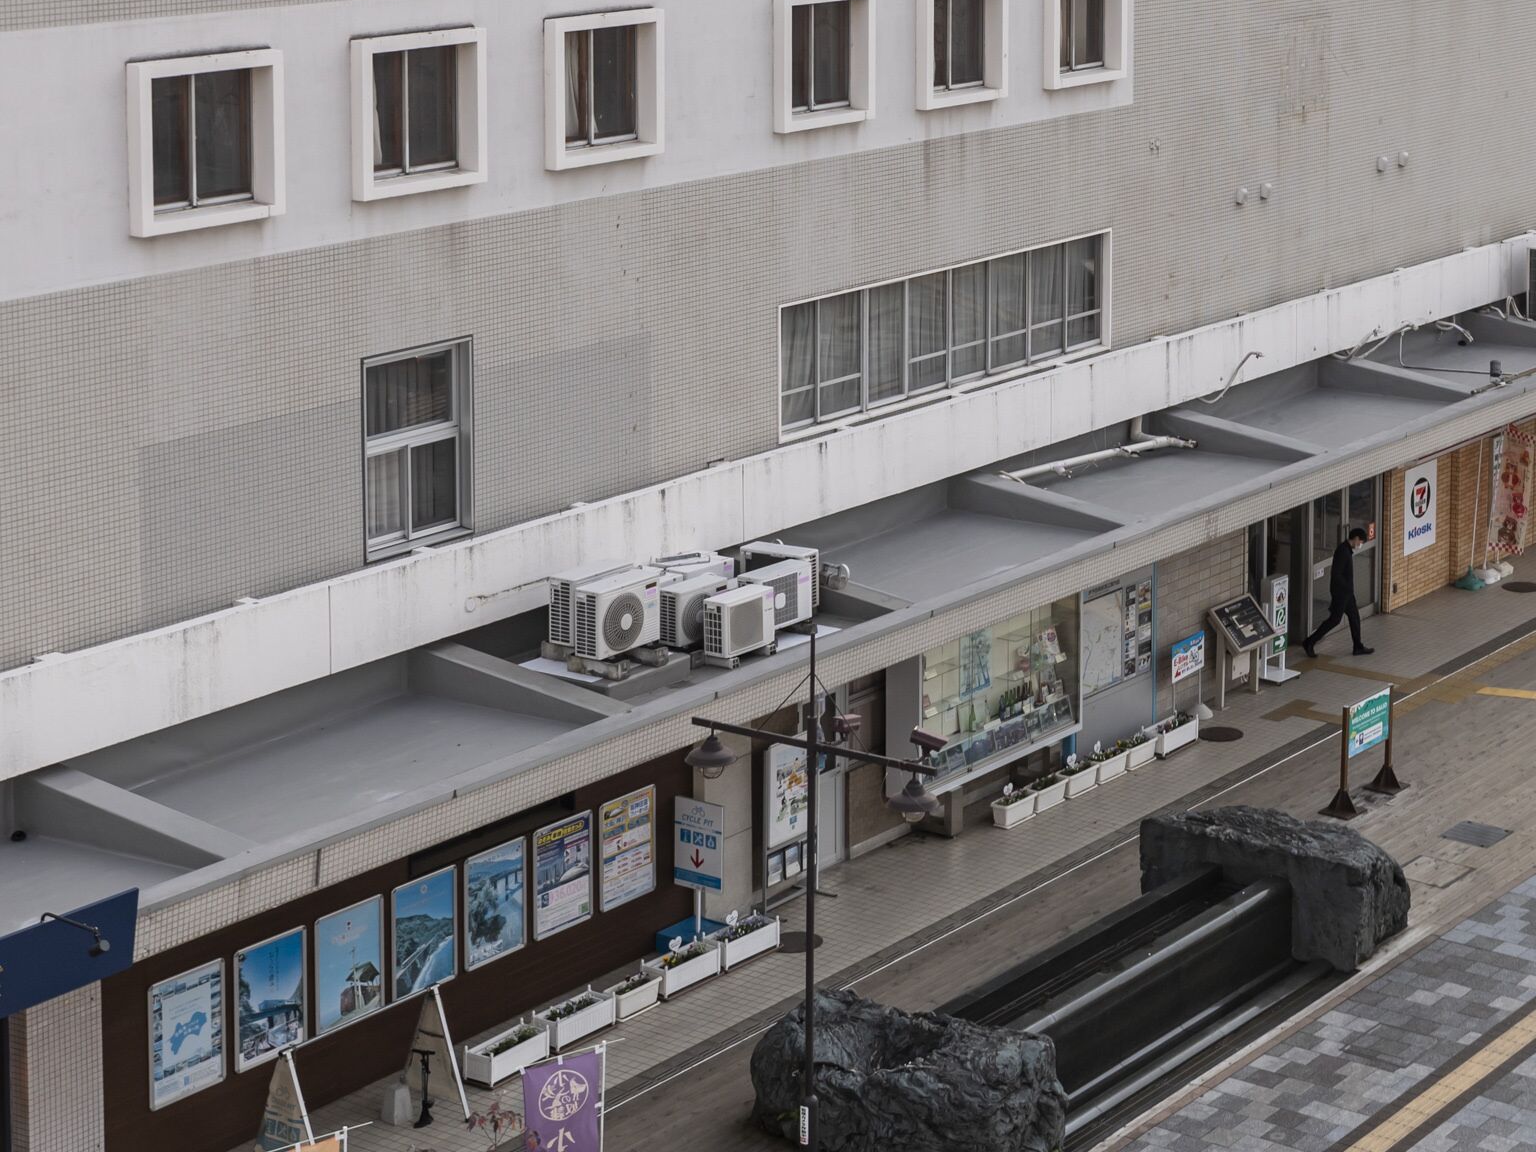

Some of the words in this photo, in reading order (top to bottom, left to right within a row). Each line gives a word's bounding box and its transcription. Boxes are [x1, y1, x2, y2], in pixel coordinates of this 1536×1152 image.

[1408, 522, 1432, 540] Kiosk
[1352, 710, 1370, 725] WELCOME
[1370, 708, 1376, 716] TO
[682, 813, 702, 825] CYCLE
[703, 818, 714, 828] PIT
